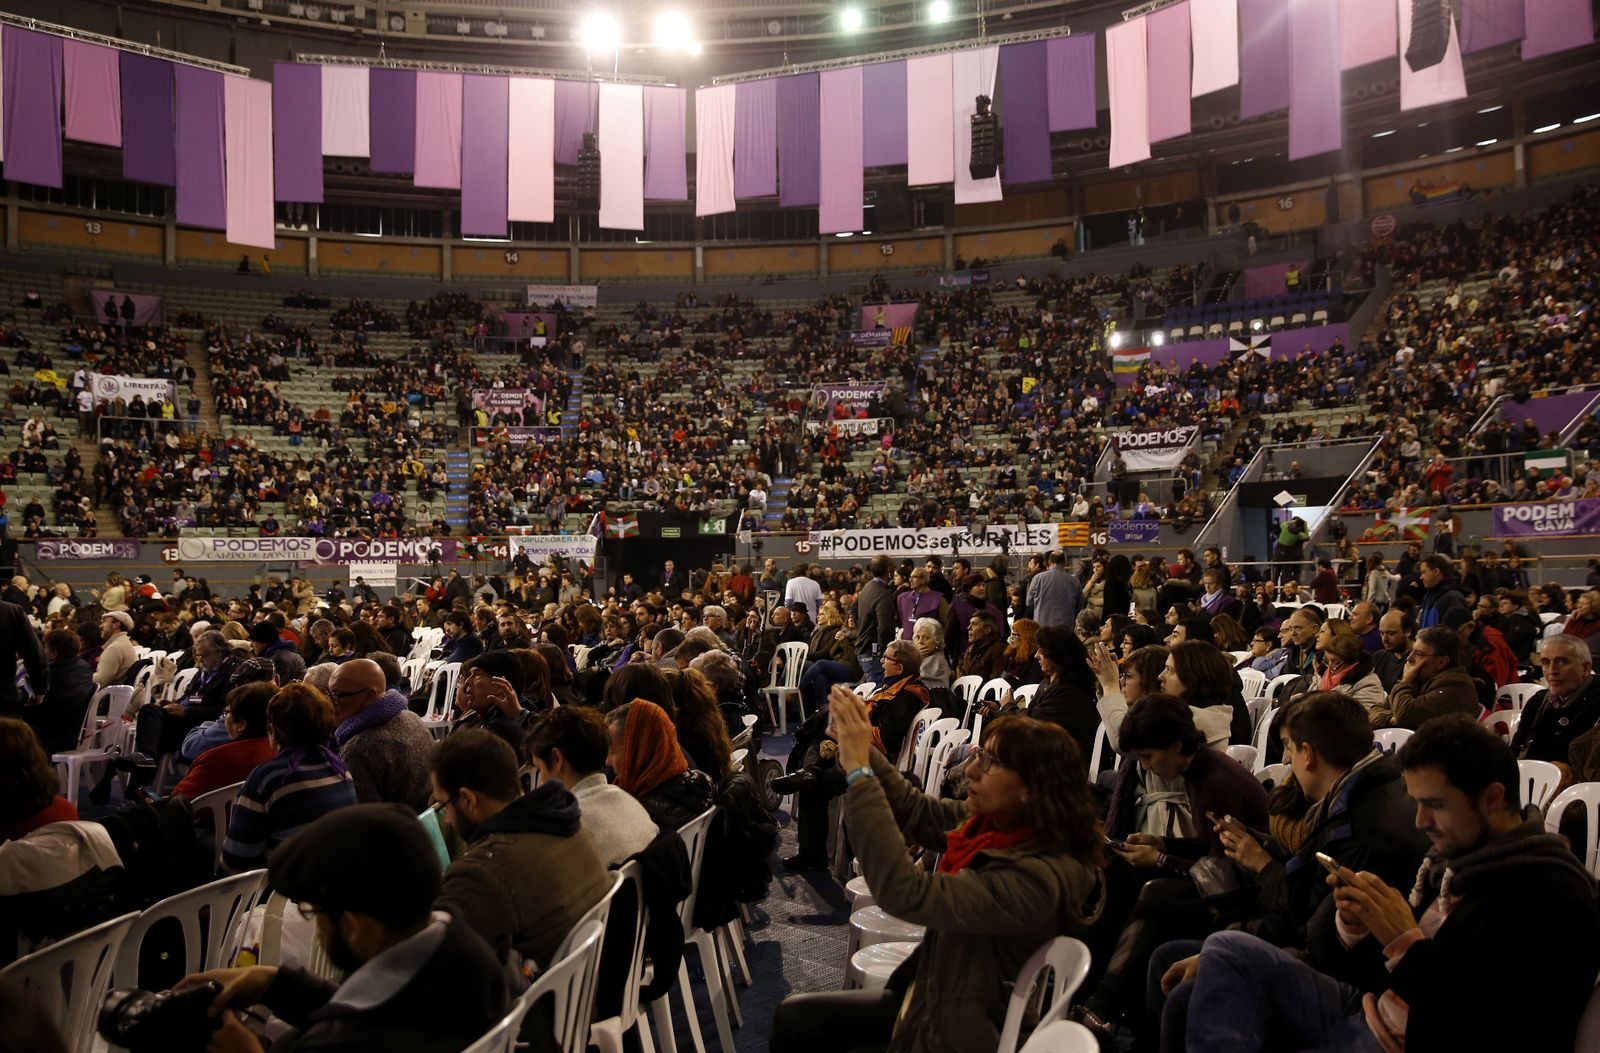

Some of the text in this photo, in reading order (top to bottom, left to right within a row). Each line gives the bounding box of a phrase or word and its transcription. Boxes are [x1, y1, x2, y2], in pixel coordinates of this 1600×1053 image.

[1278, 197, 1293, 209] 16
[85, 222, 102, 234] 13
[881, 244, 893, 255] 15
[505, 252, 518, 262] 14
[123, 381, 167, 391] LIBERTAD
[1118, 430, 1187, 448] PODEMOS
[1503, 502, 1575, 522] PODEM
[1108, 520, 1159, 534] podemos
[213, 538, 311, 551] PODEMOS
[1090, 532, 1107, 545] 16
[340, 541, 443, 558] PODEMOS
[491, 546, 508, 557] 14
[796, 541, 811, 552] 15
[162, 548, 179, 561] 13
[207, 552, 246, 560] CAMPO
[263, 551, 308, 560] MONTIEL
